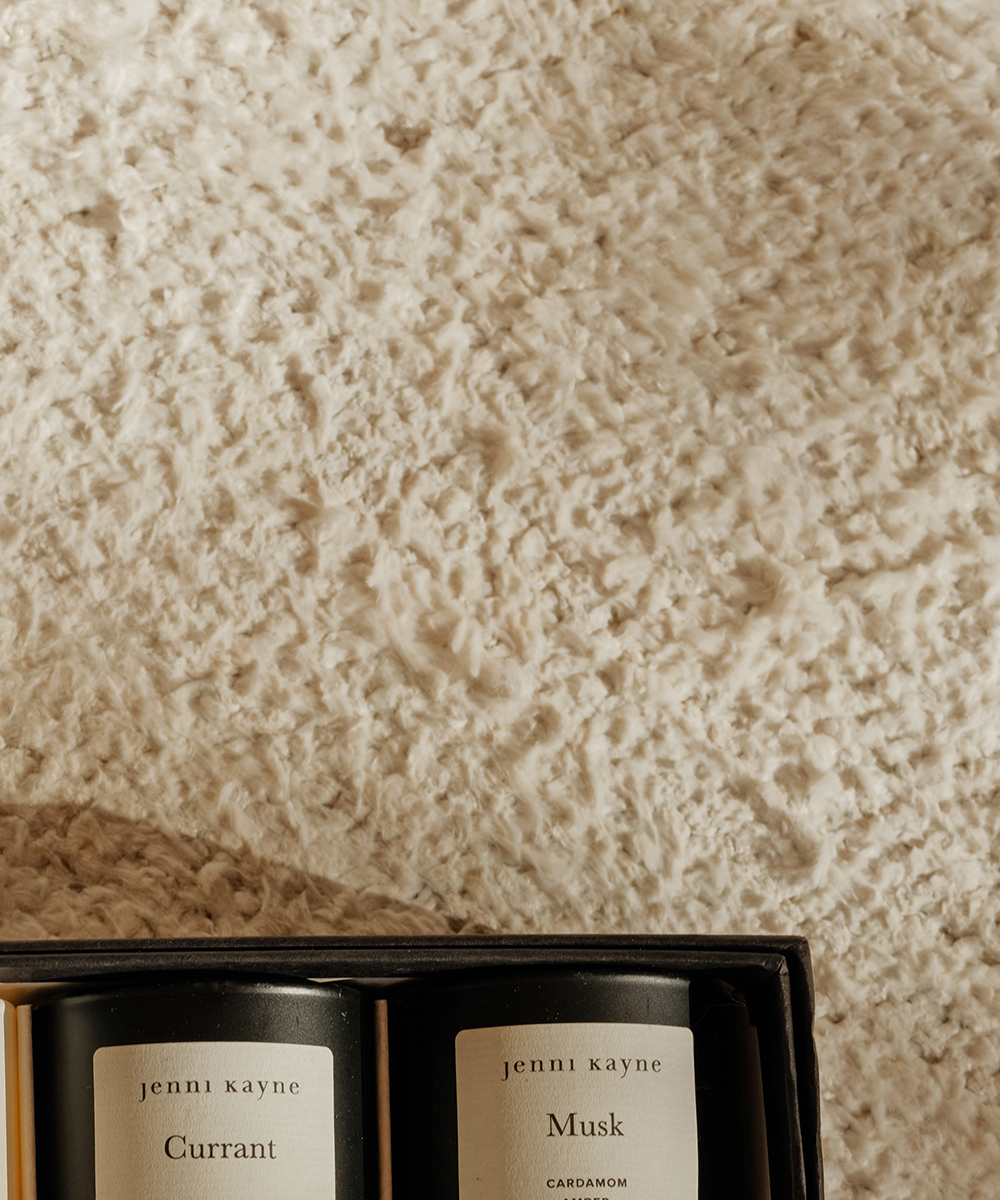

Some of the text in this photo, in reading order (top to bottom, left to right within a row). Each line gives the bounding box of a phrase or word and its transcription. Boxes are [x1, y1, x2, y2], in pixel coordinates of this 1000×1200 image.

[545, 1111, 625, 1138] Musk
[164, 1134, 277, 1161] Currant
[546, 1177, 628, 1189] CARDAMOM
